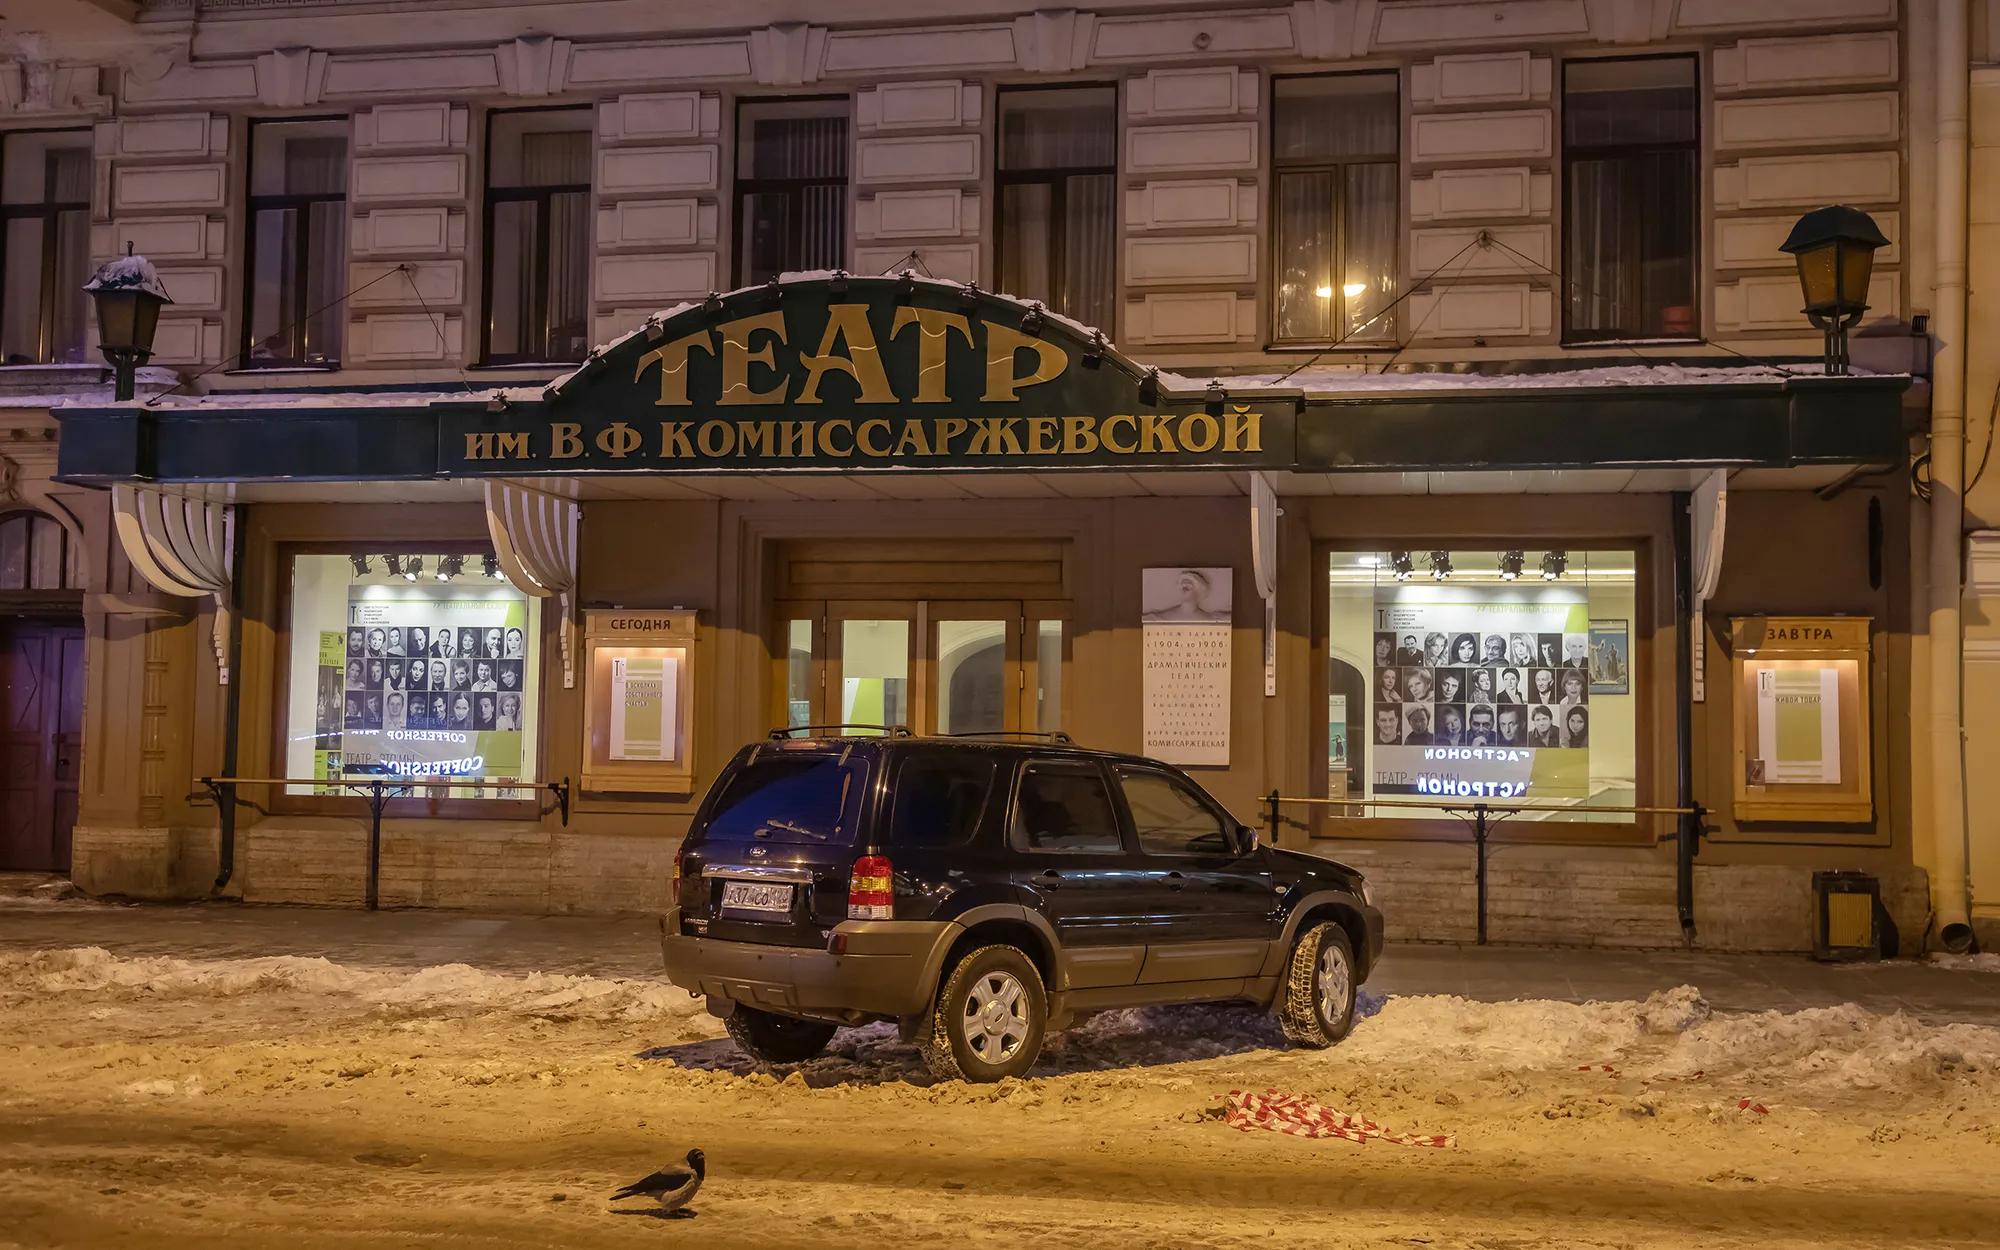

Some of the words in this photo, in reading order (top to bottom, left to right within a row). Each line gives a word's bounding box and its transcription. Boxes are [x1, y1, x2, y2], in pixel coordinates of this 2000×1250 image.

[634, 303, 1069, 406] ТЕАТР
[658, 405, 1263, 458] КОМИССАРЖЕВСКОЙ
[611, 619, 670, 631] СЕГОДНЯ
[1767, 628, 1833, 640] ЗАВТРА
[1198, 640, 1224, 648] 1906
[1376, 771, 1407, 784] ТЕАТР
